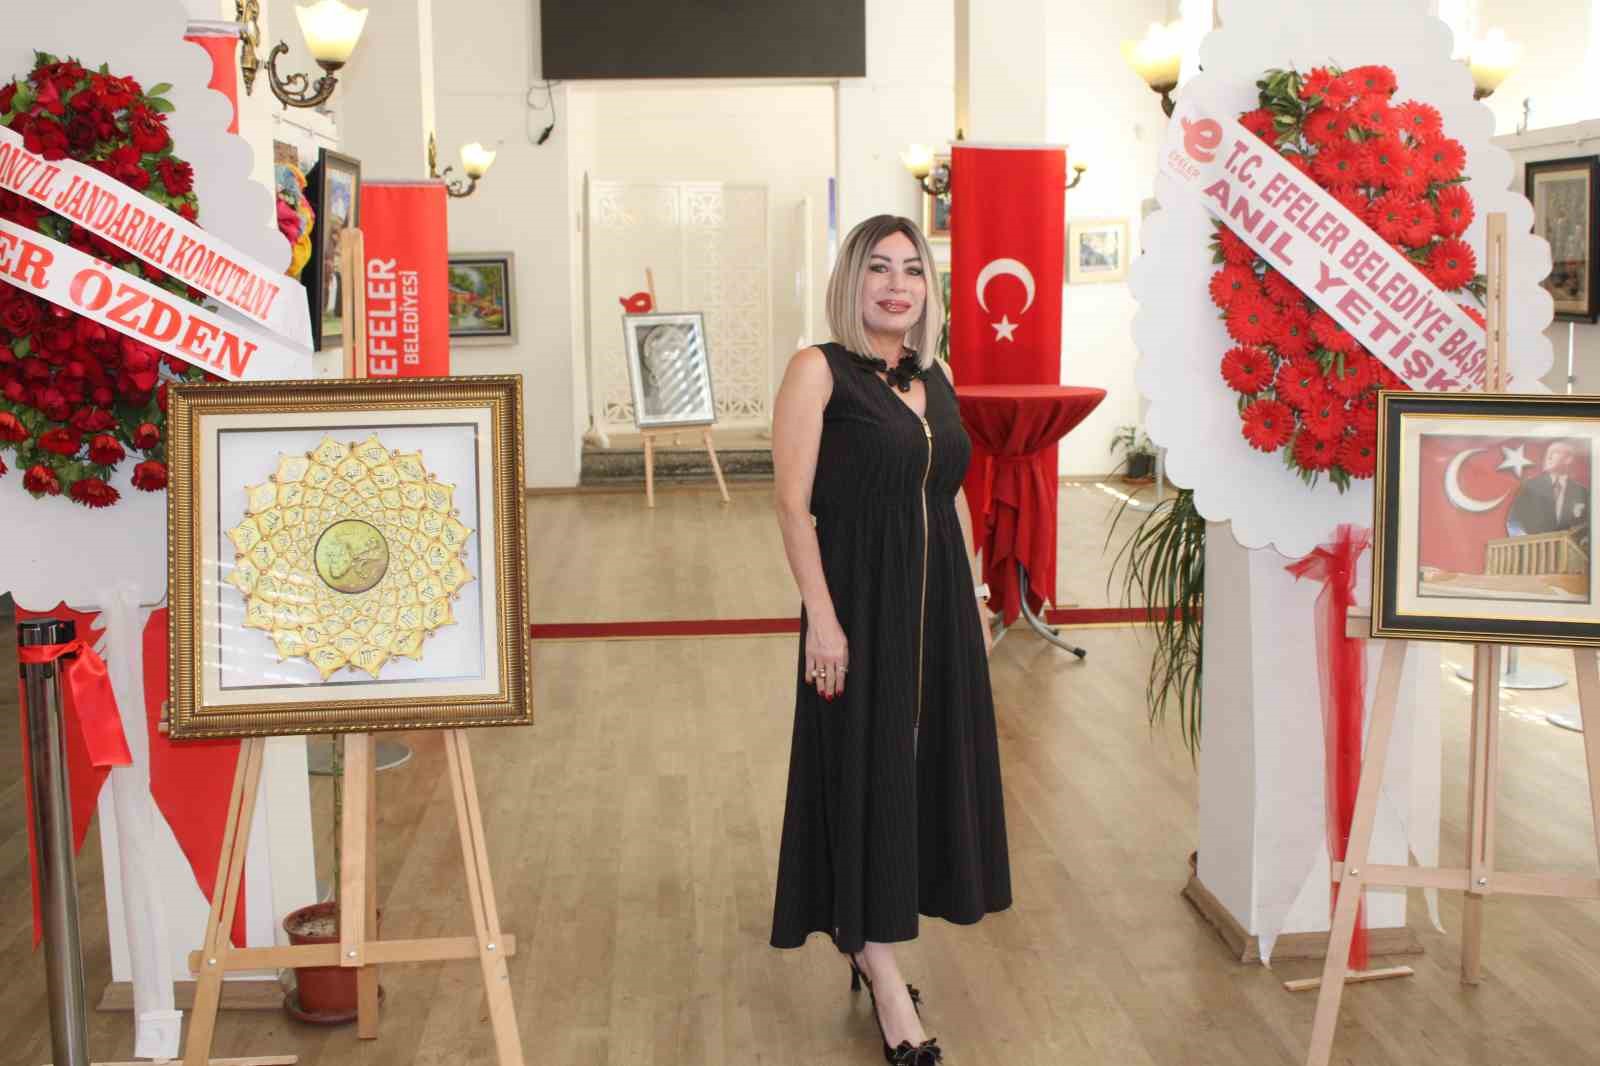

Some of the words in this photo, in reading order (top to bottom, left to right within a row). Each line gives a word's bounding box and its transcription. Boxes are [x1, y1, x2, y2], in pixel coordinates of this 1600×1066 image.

[54, 175, 173, 265] JANDARMA
[167, 235, 280, 321] KOMUTANI
[1203, 179, 1294, 267] ANIL
[1313, 261, 1472, 392] YETİŞK
[1224, 140, 1263, 189] T.C.
[1259, 173, 1350, 254] EFELER
[1339, 239, 1452, 343] BELEDİYE
[1438, 327, 1513, 391] BAŞK
[68, 257, 258, 378] ÖZDEN
[367, 258, 398, 376] EFELER
[398, 270, 420, 365] BELEDİYESİ
